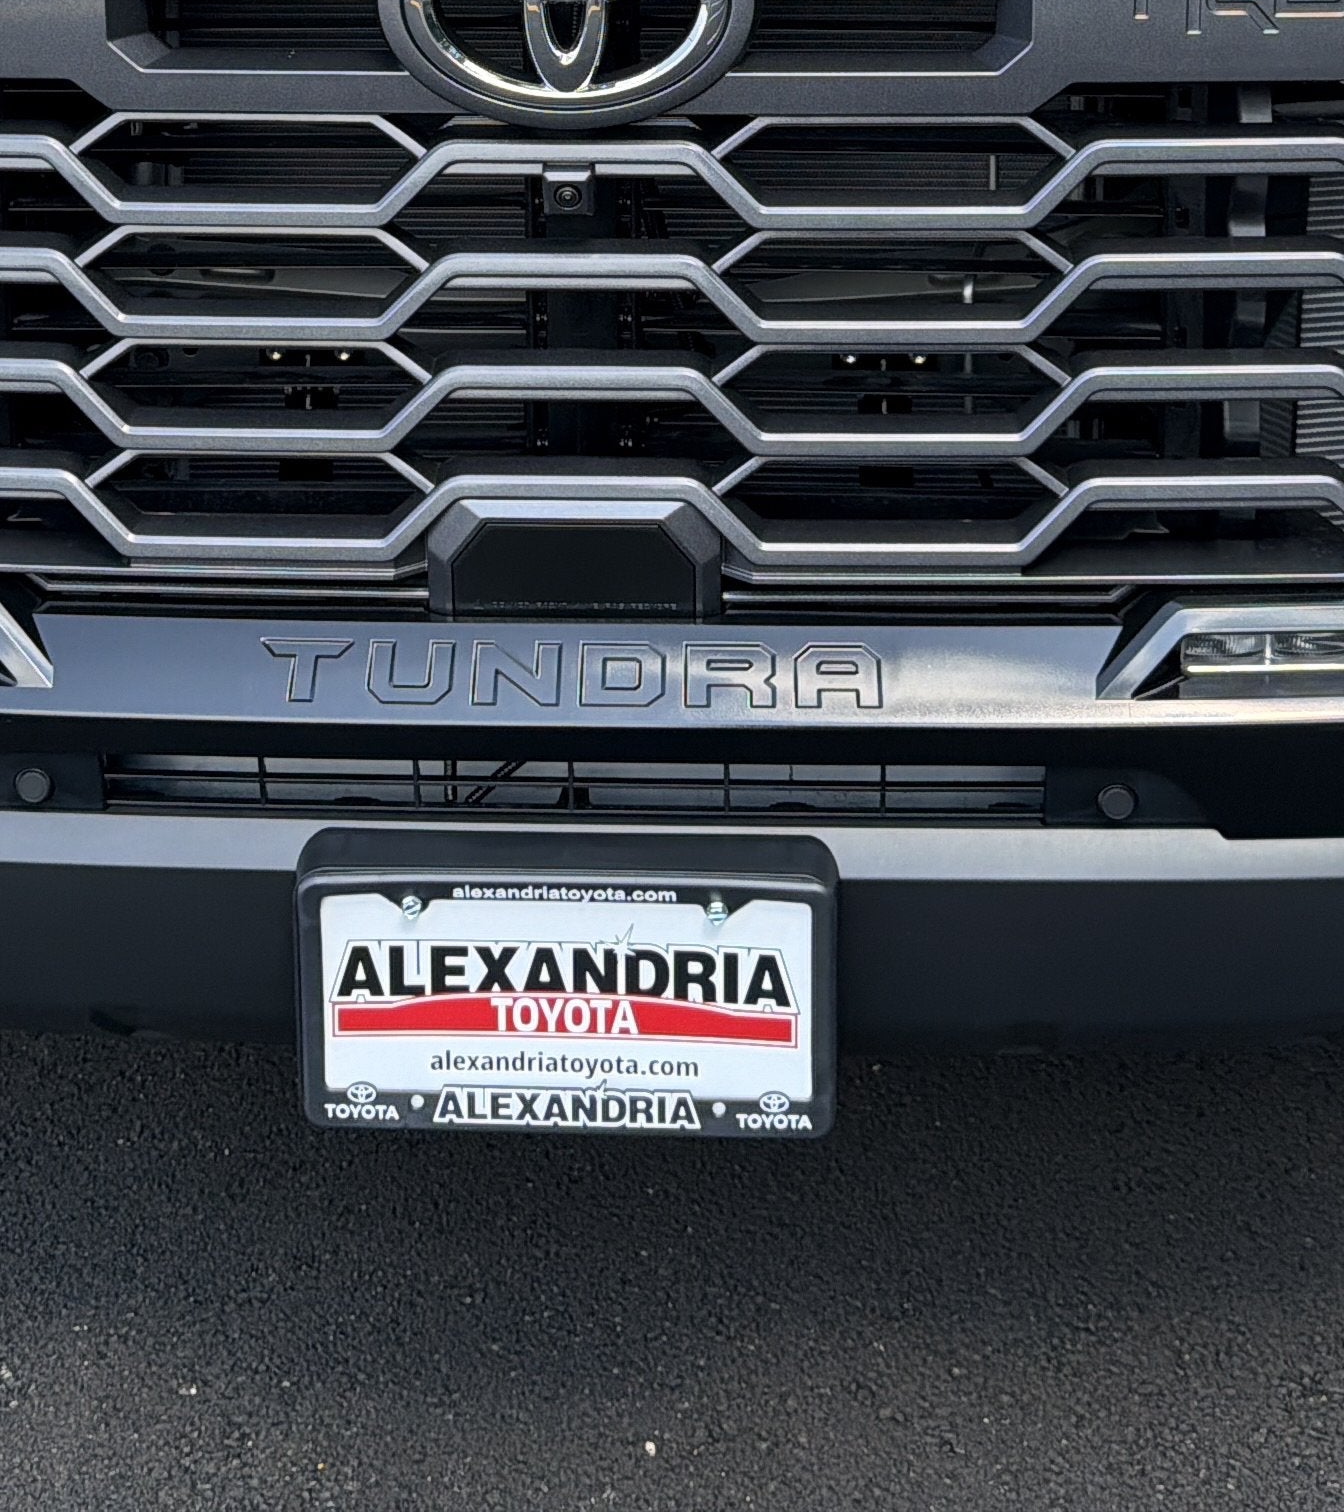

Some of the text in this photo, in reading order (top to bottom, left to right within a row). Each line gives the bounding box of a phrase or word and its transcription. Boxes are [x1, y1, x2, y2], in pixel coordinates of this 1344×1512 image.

[260, 637, 884, 708] TUNDRA
[452, 884, 677, 904] alexandriatoyota.com
[335, 944, 793, 1009] ALEXANDRIA
[491, 997, 639, 1034] TOYOTA
[430, 1049, 699, 1080] alexandriatoyota.com
[324, 1103, 400, 1121] TOYOTA
[435, 1089, 699, 1128] ALEXANDRIA
[735, 1112, 813, 1131] TOYOTA
